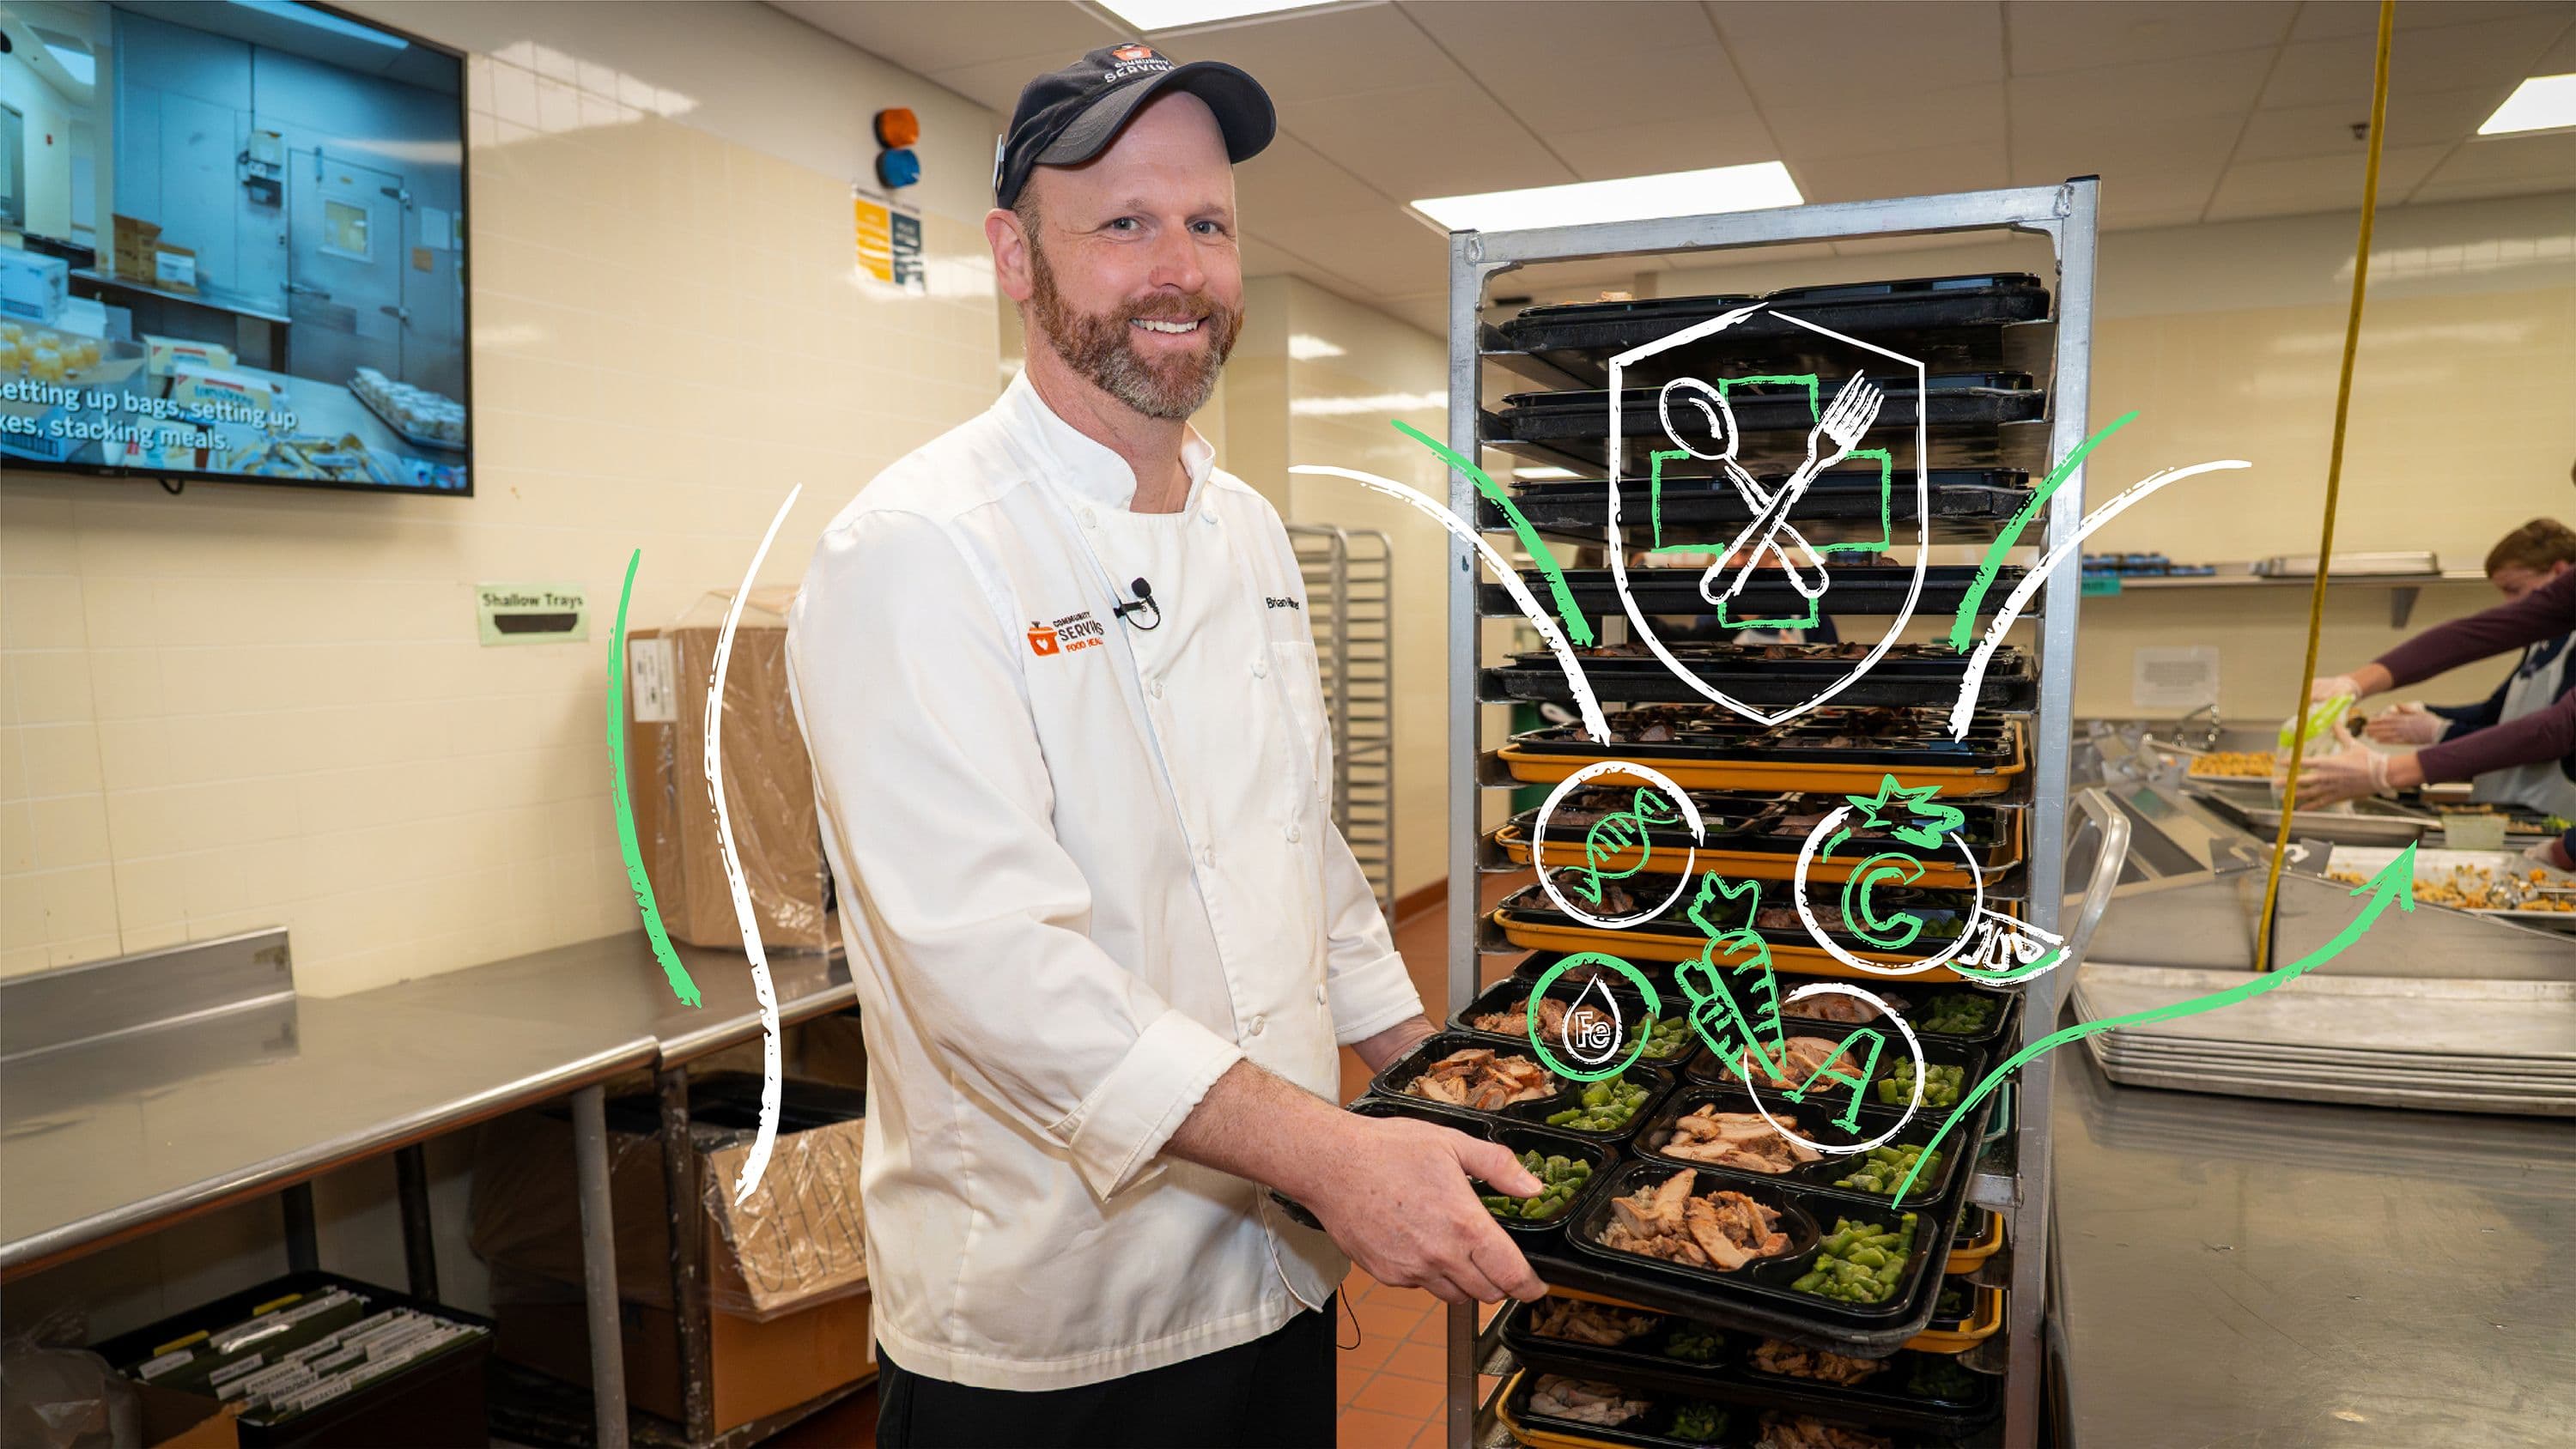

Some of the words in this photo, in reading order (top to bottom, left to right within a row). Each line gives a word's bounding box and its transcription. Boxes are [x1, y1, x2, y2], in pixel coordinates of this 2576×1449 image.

[0, 378, 80, 410] etting
[87, 391, 118, 412] up
[124, 389, 185, 420] bags,
[191, 401, 265, 427] setting
[270, 409, 297, 429] up
[50, 416, 155, 449] stacking
[160, 427, 232, 451] meals.
[483, 592, 539, 606] Shallow
[544, 592, 583, 609] Trays
